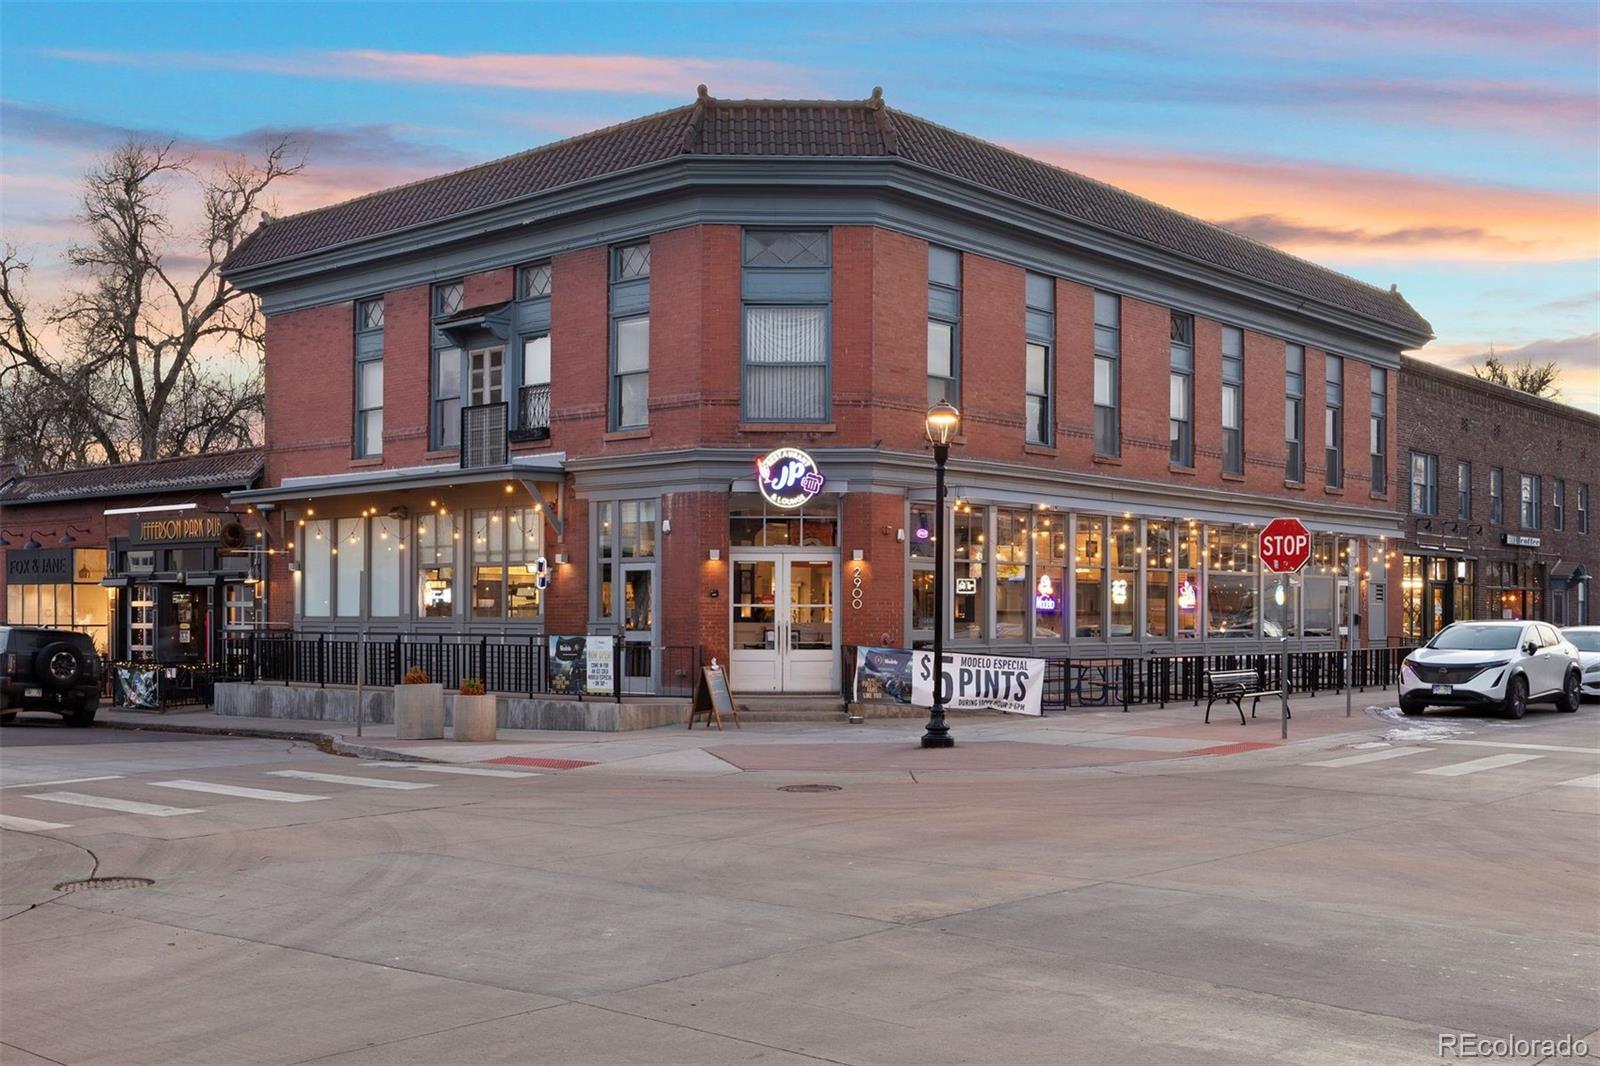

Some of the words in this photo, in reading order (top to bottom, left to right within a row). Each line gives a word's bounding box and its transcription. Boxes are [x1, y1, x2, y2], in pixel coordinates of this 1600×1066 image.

[771, 461, 805, 490] JP
[140, 519, 182, 540] JEFFERSON
[184, 519, 204, 538] PARK
[207, 518, 222, 537] PUB
[1262, 535, 1307, 556] STOP
[10, 559, 30, 575] FOX
[31, 559, 39, 574] &
[42, 557, 67, 574] JANE
[851, 566, 863, 610] 2900
[960, 656, 991, 669] MODELO
[993, 659, 1028, 671] ESPECIAL
[959, 667, 1029, 702] PINTS
